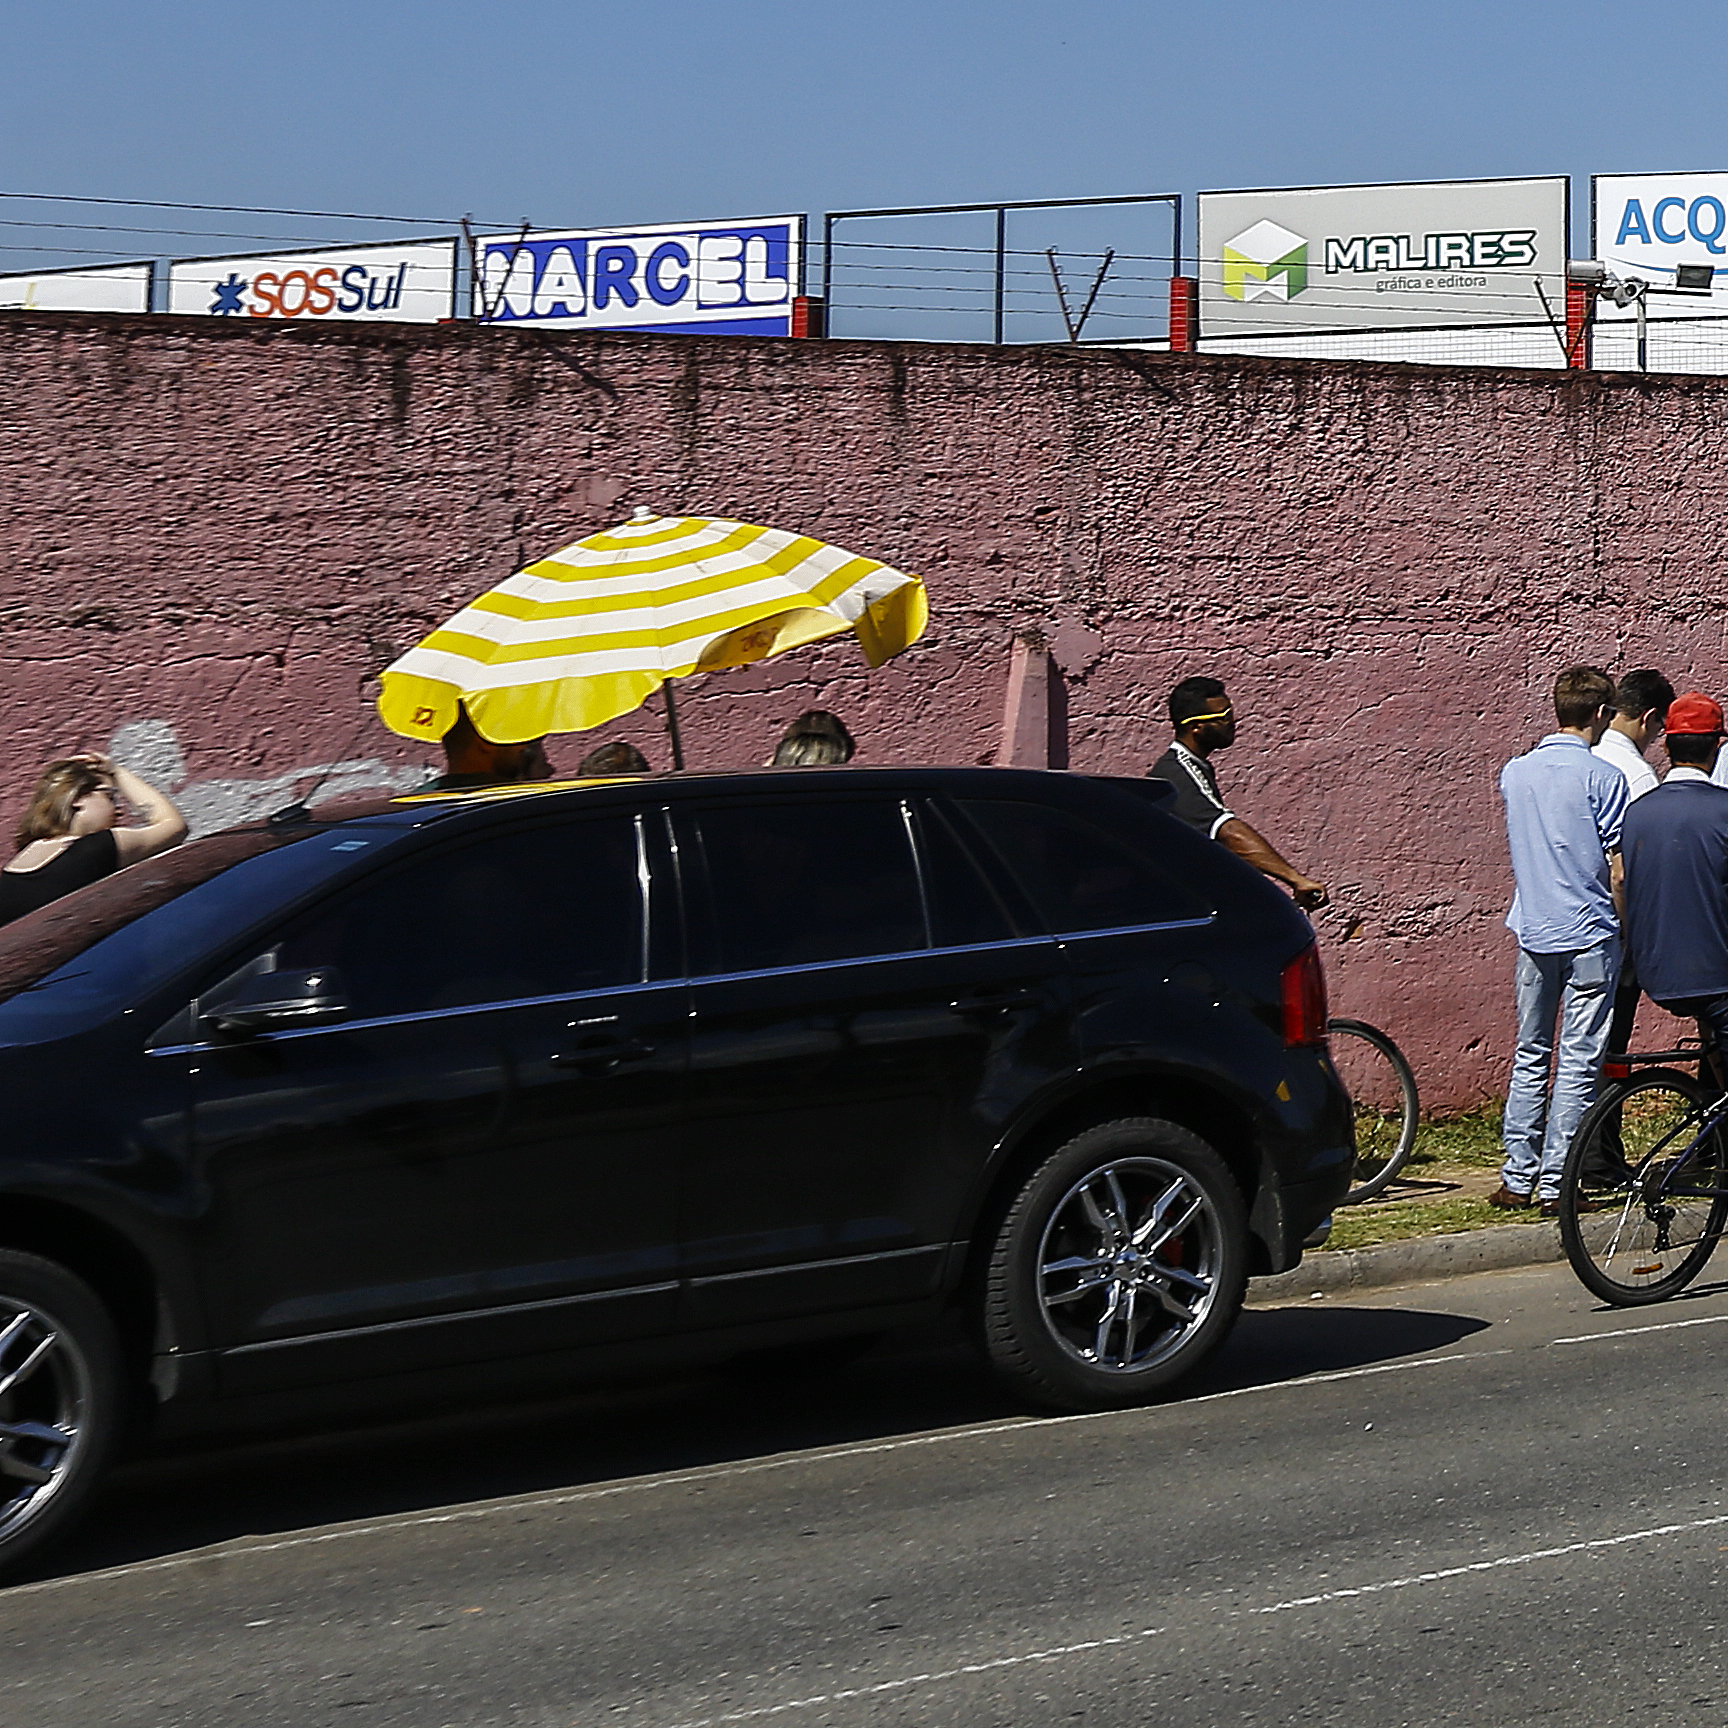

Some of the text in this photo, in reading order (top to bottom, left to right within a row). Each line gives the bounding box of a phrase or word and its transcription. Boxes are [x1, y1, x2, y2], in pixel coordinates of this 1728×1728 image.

[1324, 229, 1539, 275] MALIRES
[483, 233, 789, 319] MARCEL
[1375, 274, 1487, 293] gráfica e editora
